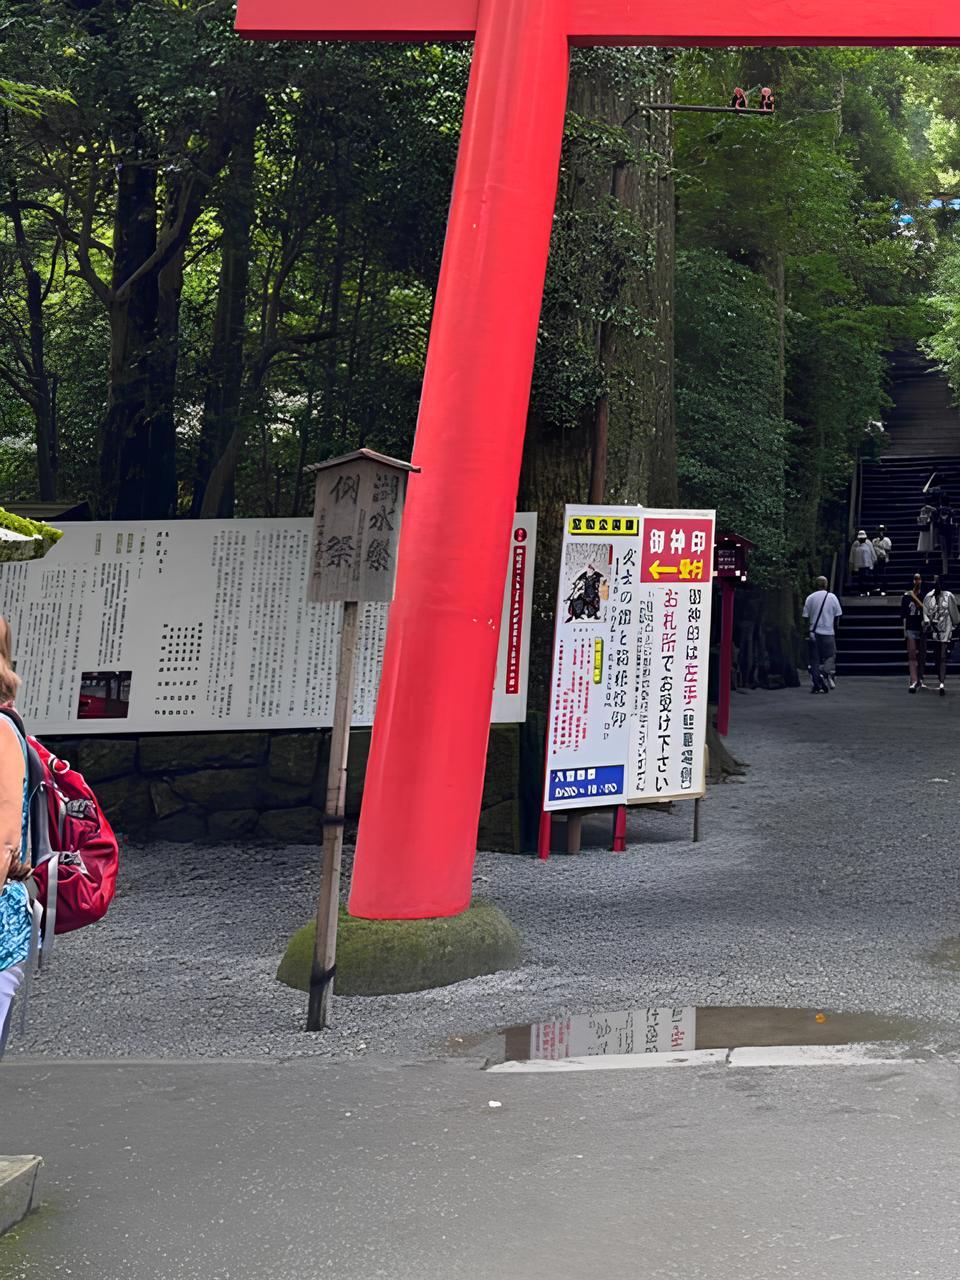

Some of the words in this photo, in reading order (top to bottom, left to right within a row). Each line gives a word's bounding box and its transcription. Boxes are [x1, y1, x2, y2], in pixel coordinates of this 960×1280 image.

[655, 588, 679, 793] お札所でお受け下さい
